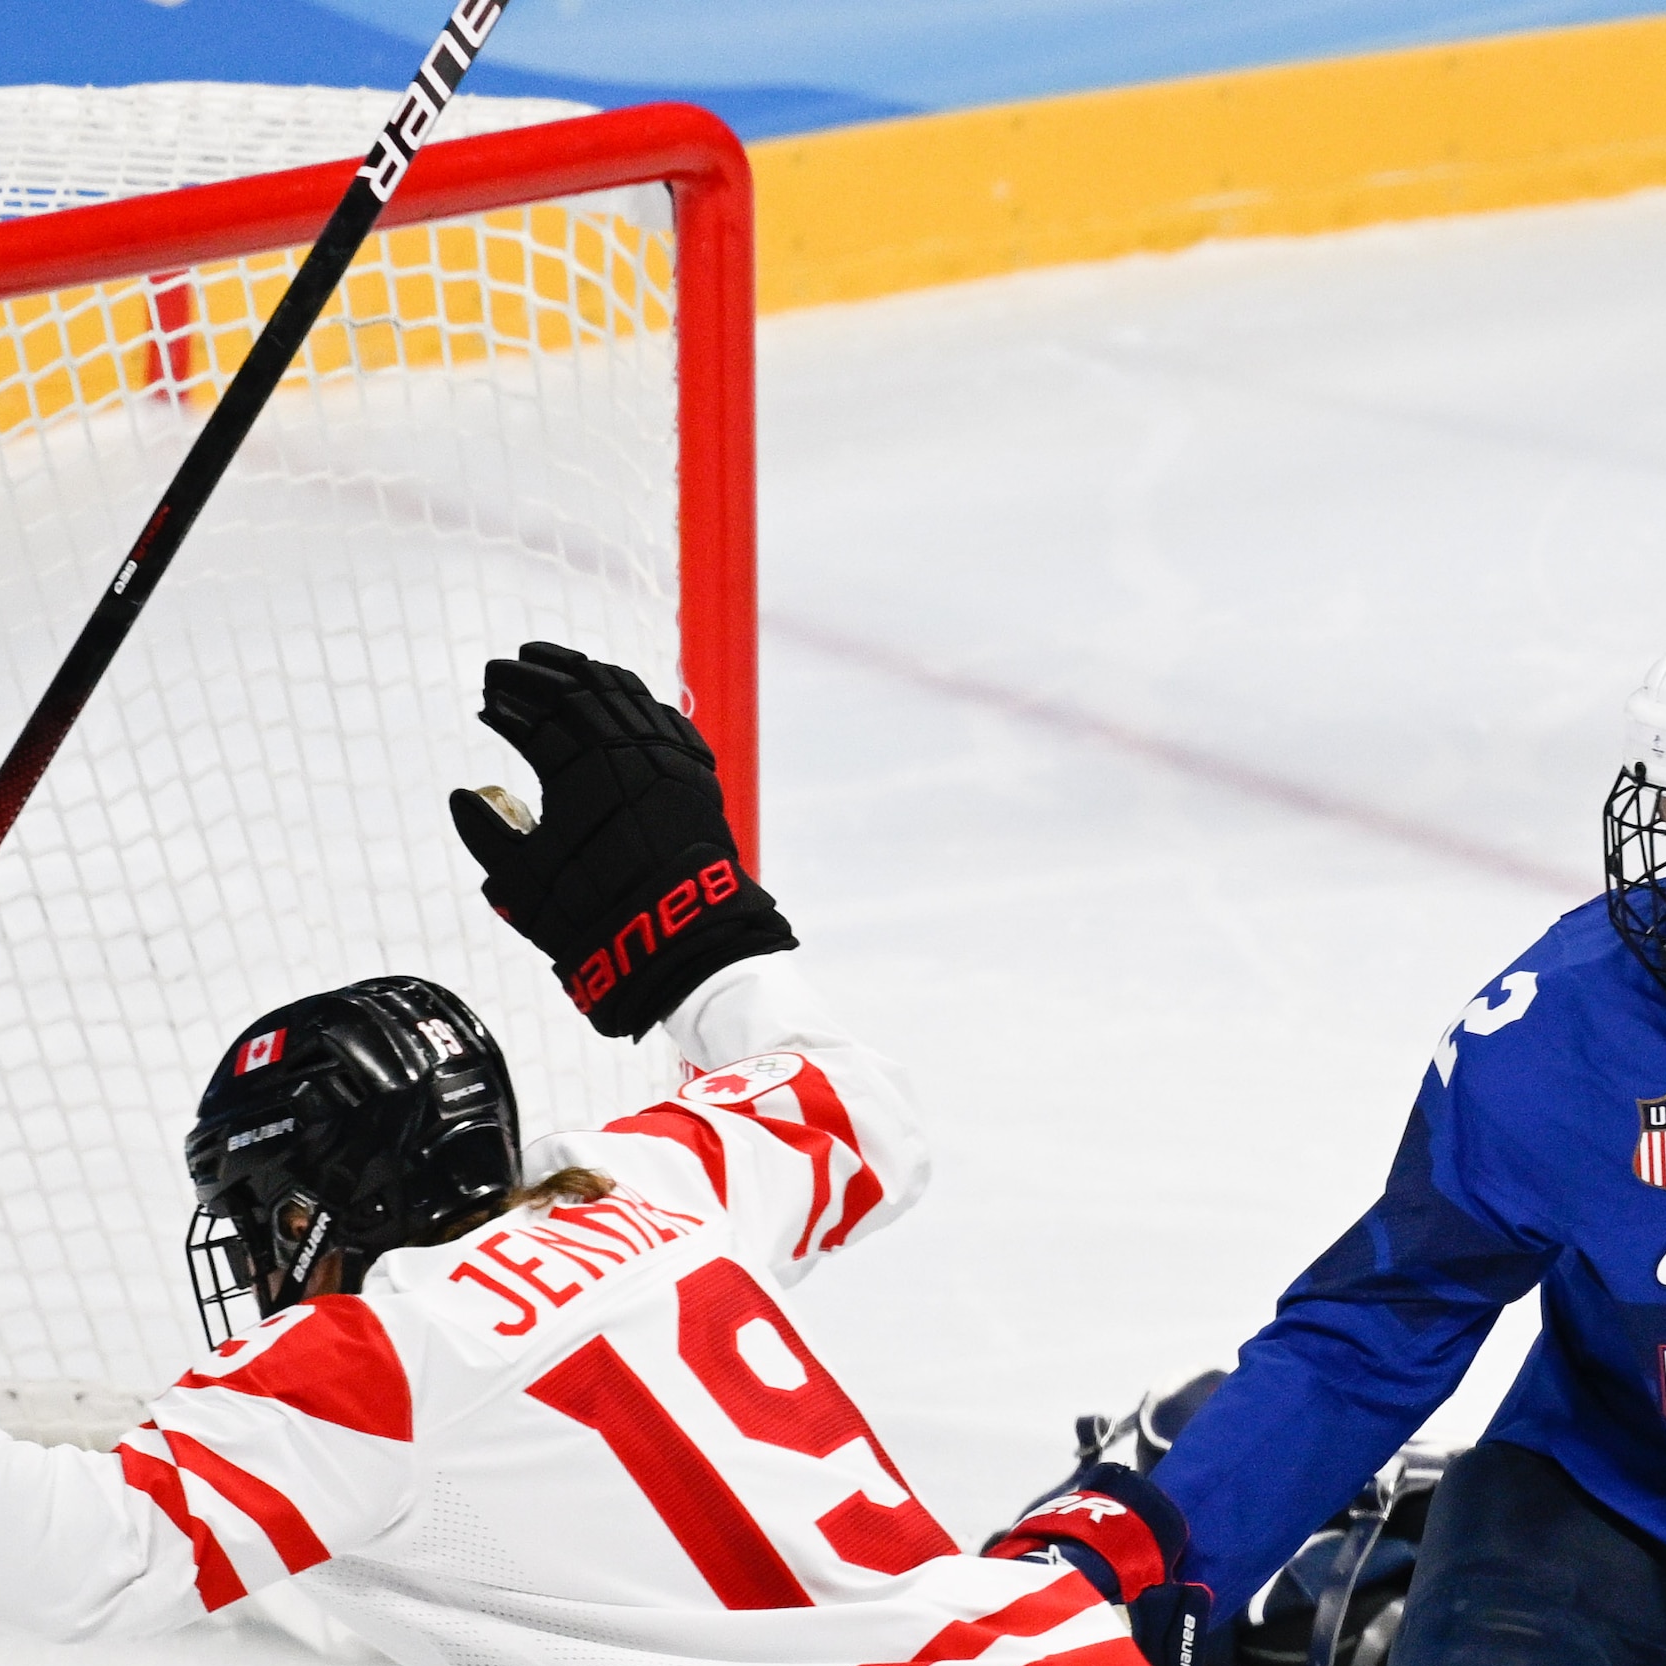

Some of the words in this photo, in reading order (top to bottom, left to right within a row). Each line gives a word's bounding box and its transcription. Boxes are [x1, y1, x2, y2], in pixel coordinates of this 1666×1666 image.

[356, 0, 501, 203] AUER
[416, 1018, 464, 1061] 19
[1432, 970, 1539, 1089] 2
[292, 1211, 332, 1283] BAUER
[525, 1257, 960, 1611] 19
